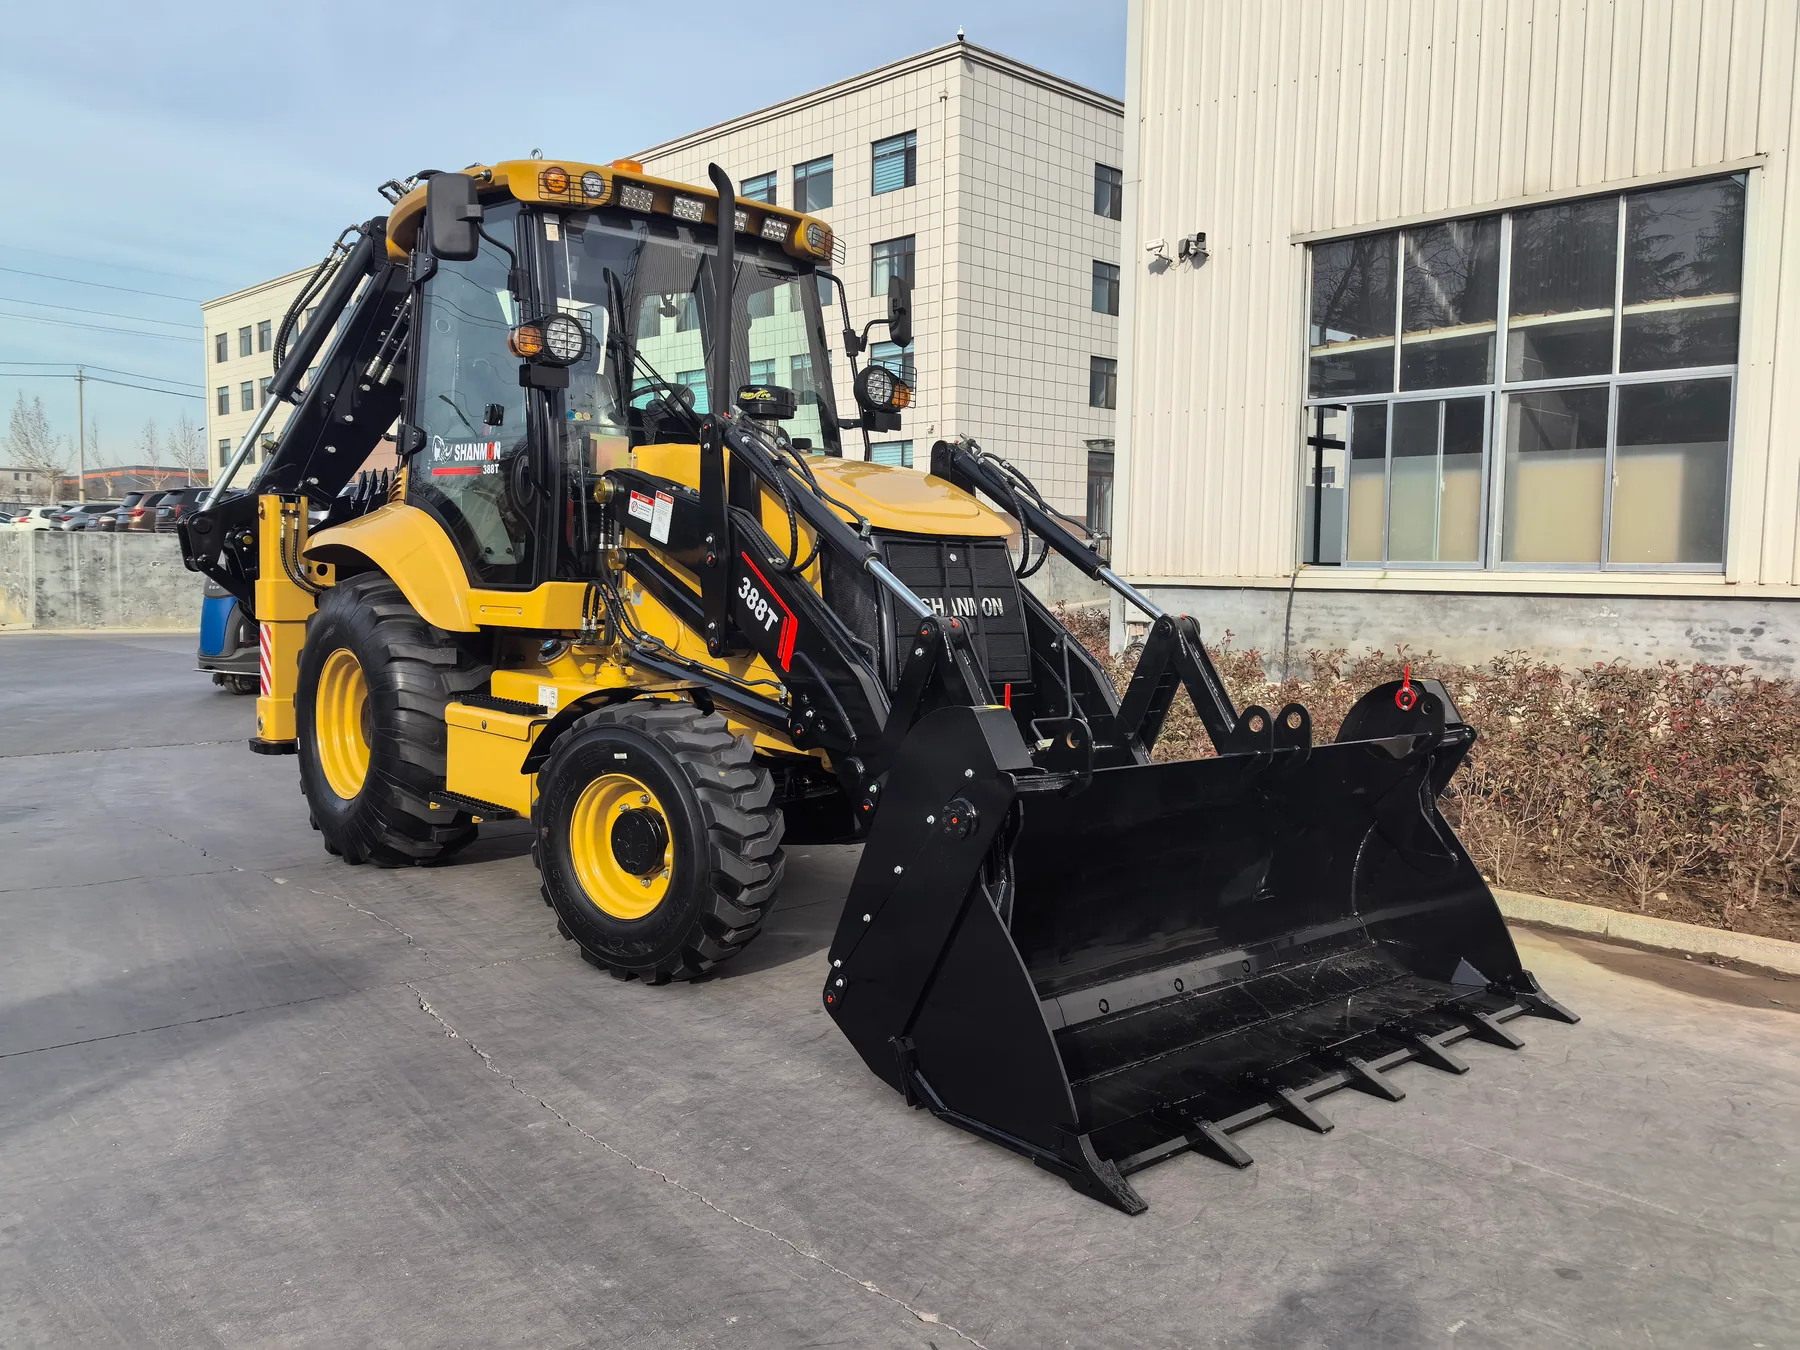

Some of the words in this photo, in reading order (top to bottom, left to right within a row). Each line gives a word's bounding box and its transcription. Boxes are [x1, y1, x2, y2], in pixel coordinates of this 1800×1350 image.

[454, 441, 501, 462] SHANMON
[482, 463, 500, 475] 388T
[738, 576, 779, 632] 388T
